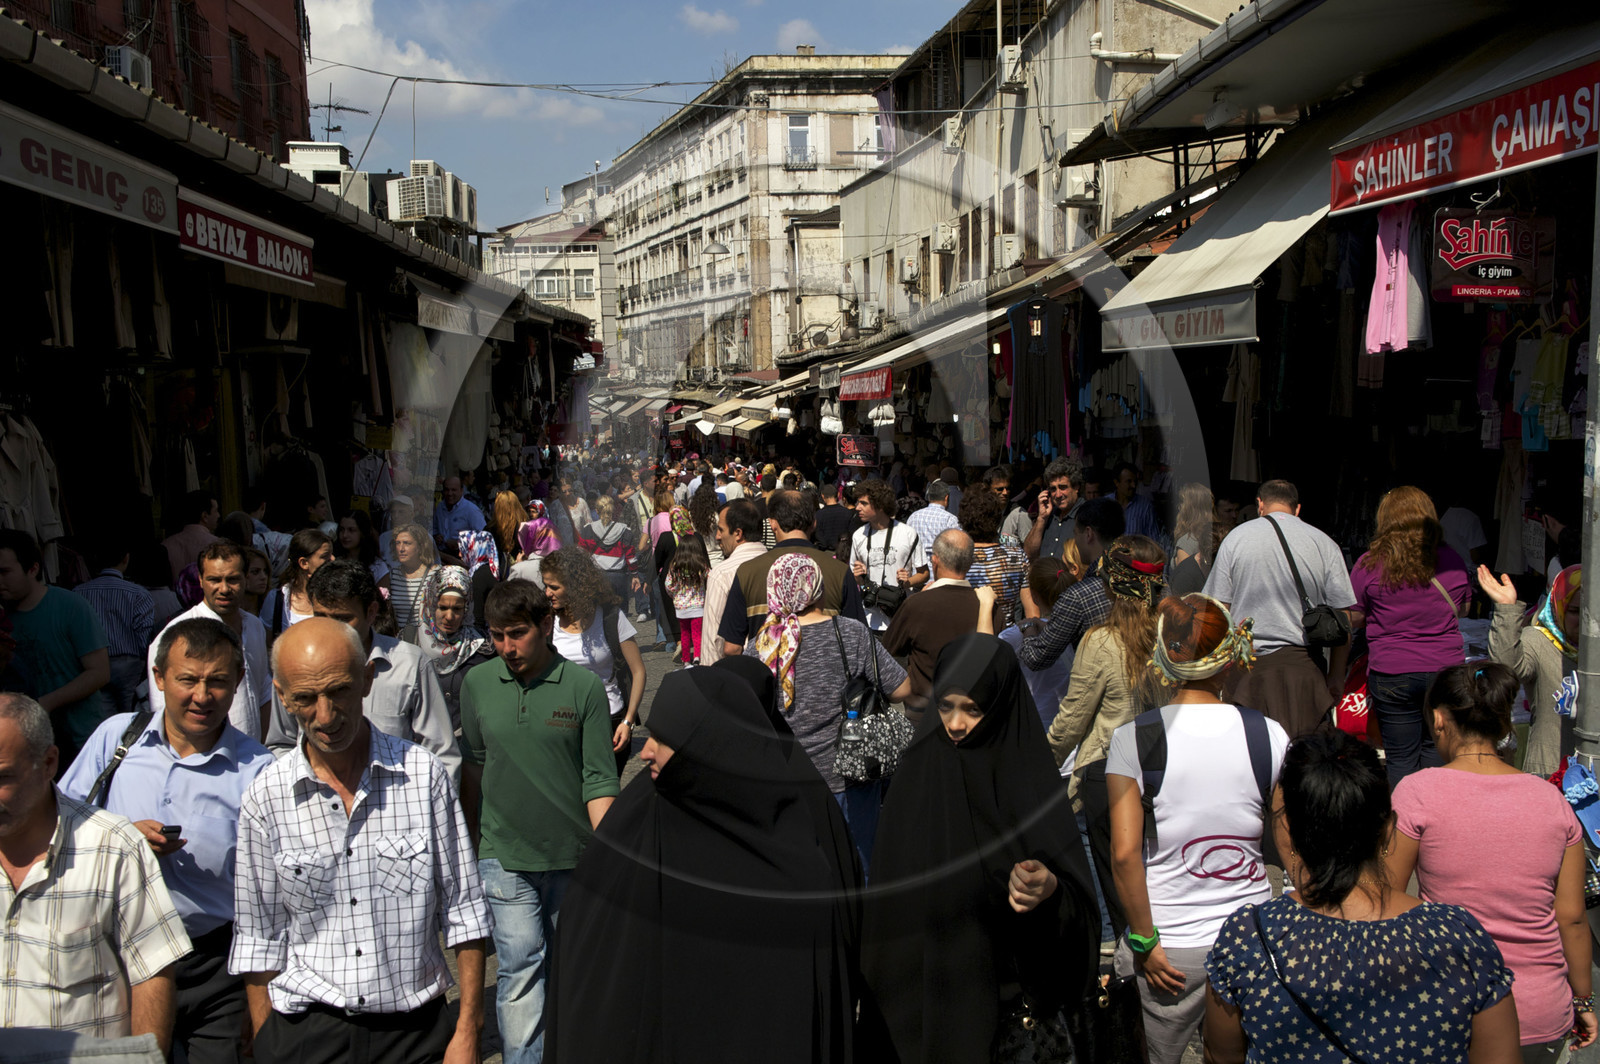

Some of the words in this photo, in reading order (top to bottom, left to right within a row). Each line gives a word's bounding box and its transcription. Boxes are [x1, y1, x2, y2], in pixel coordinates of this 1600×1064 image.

[1353, 131, 1453, 205] ŞAHİNLER
[1491, 82, 1600, 170] ÇAMAŞI
[19, 137, 129, 212] GENÇ
[144, 191, 165, 216] 135
[196, 213, 248, 260] BEYAZ
[257, 235, 303, 276] BALON
[1457, 287, 1492, 296] LINGERIA
[1478, 265, 1486, 278] iç
[1488, 265, 1512, 279] giyim
[1174, 305, 1225, 339] GİYİM
